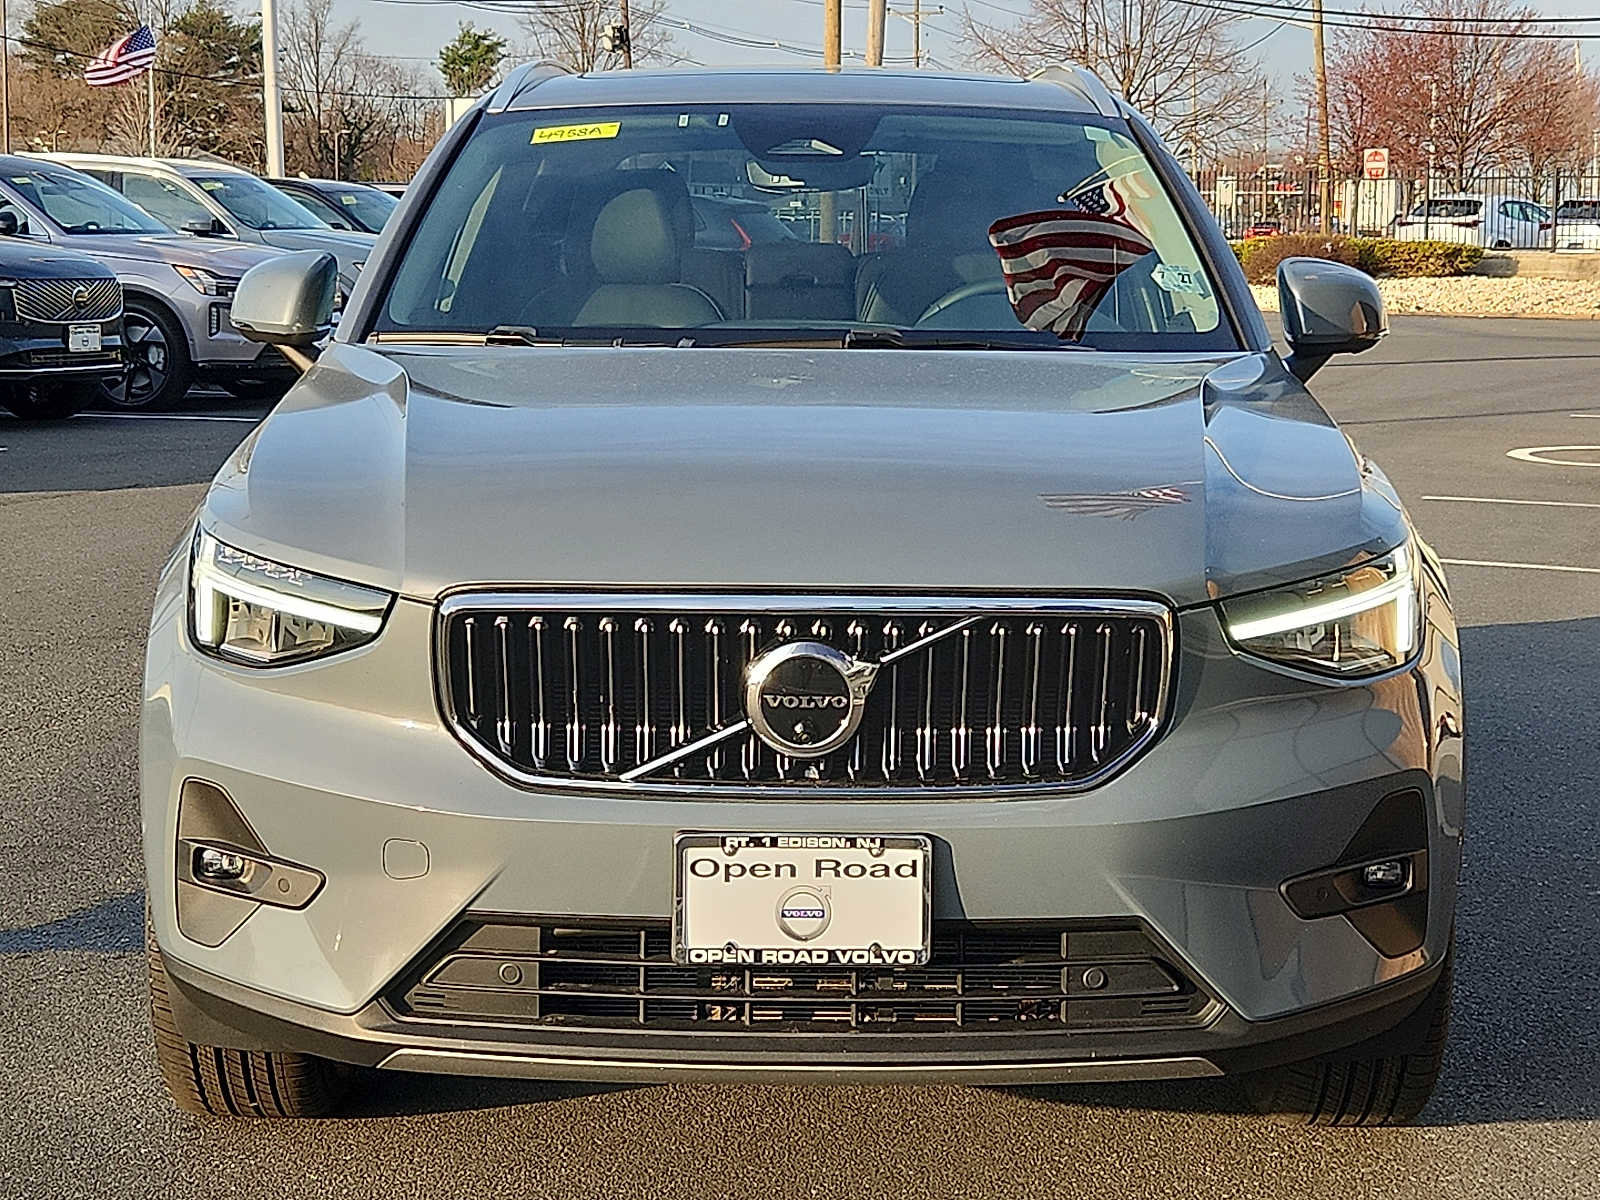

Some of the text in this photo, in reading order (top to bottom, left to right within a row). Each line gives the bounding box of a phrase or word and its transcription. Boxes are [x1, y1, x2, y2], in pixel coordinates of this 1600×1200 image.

[1177, 272, 1192, 284] 27
[763, 694, 848, 709] VOLVO
[761, 836, 771, 848] 1
[856, 837, 881, 848] NJ
[689, 858, 918, 882] Open Road
[783, 909, 824, 918] VOLVO
[689, 949, 916, 964] OPEN ROAD VOLVO
